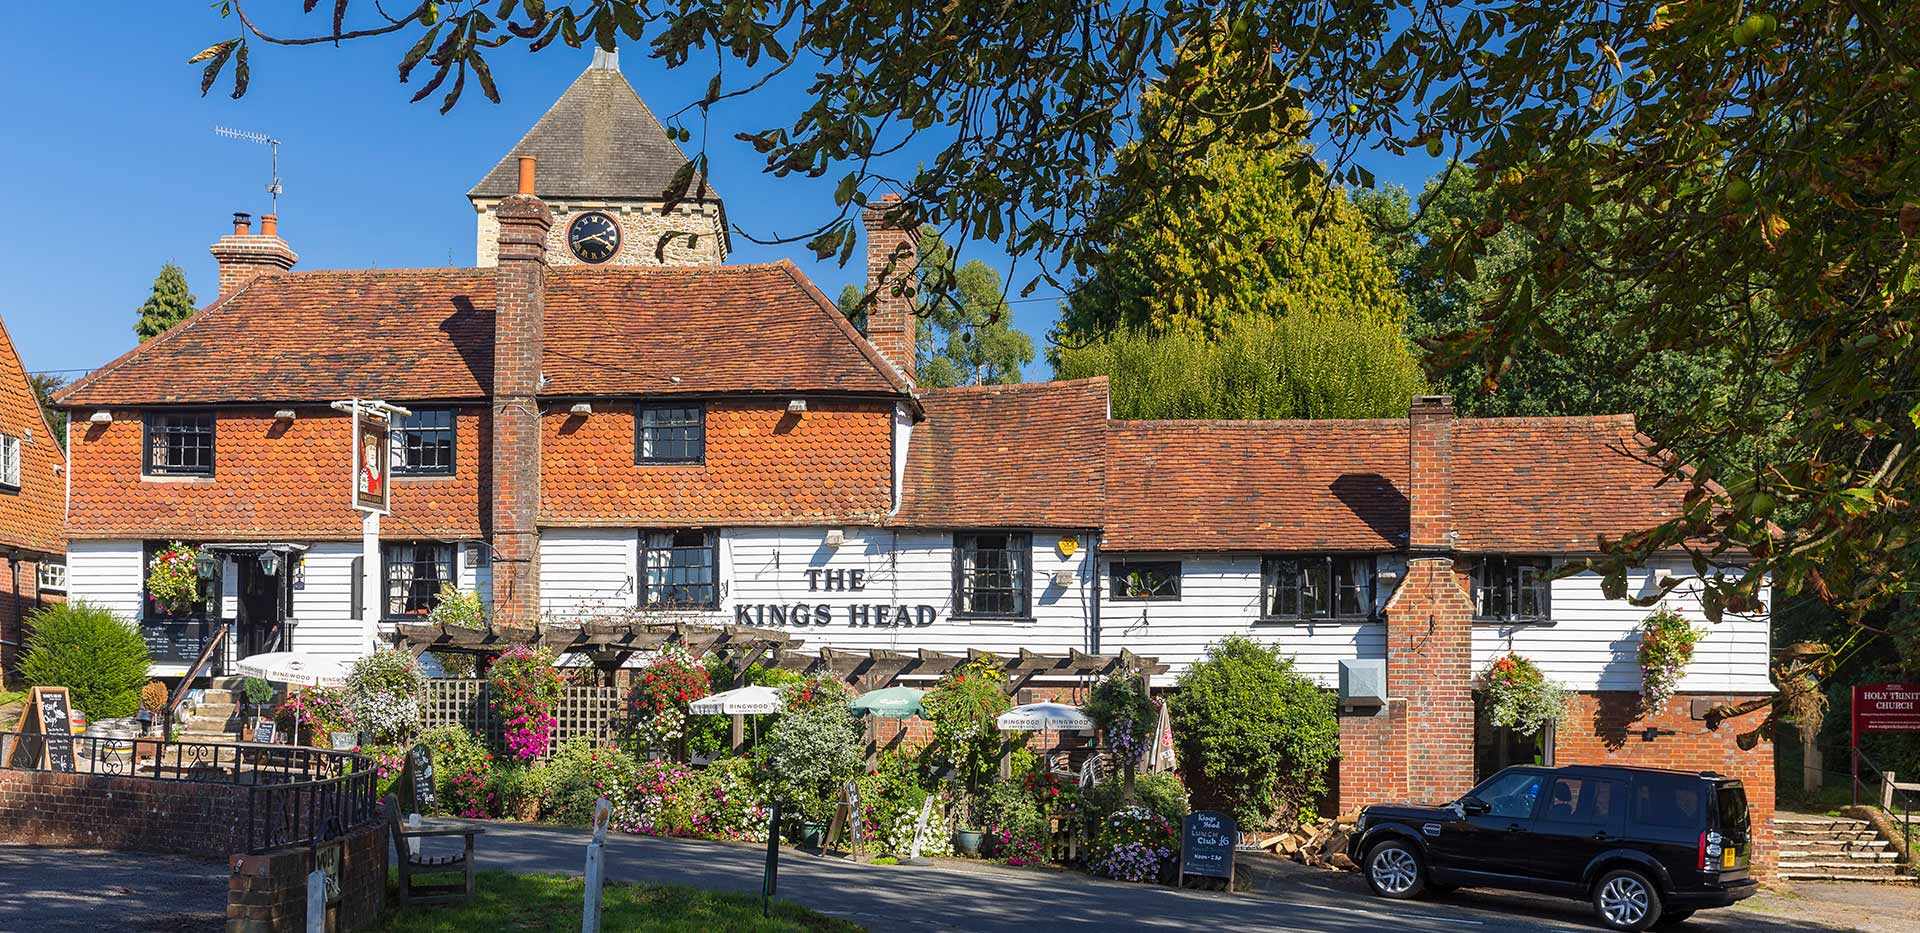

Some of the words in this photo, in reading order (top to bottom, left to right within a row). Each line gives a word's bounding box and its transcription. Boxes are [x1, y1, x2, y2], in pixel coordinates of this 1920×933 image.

[803, 568, 866, 593] THE
[733, 603, 833, 628] KINGS
[847, 604, 938, 629] HEAD
[272, 671, 311, 681] RINGWOOD
[1863, 691, 1888, 700] HOLY
[1890, 691, 1920, 700] TRINIT
[1876, 701, 1913, 710] CHURCH
[1197, 837, 1217, 845] Club
